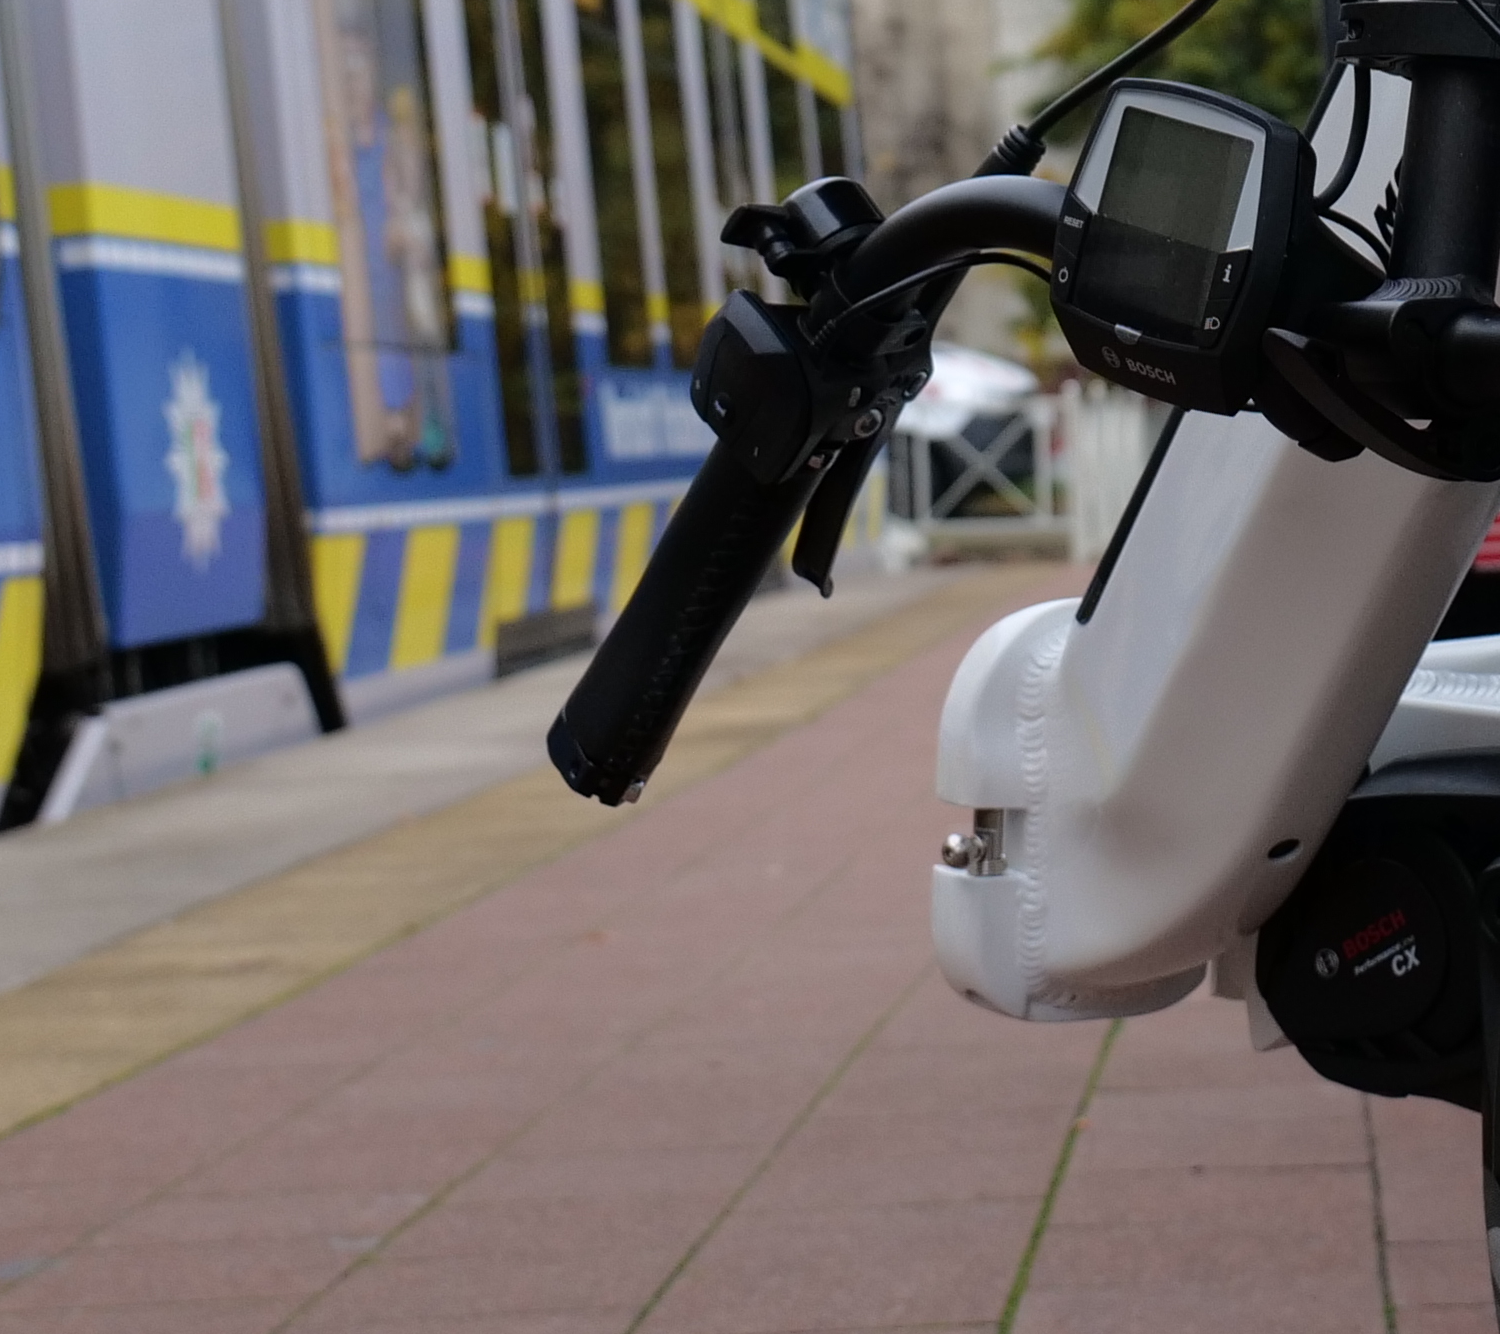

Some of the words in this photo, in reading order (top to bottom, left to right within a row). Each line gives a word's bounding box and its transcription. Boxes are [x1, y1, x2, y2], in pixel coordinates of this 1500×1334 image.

[1125, 356, 1177, 385] BOSCH
[1342, 908, 1407, 960] BOSCH
[1391, 944, 1420, 977] CX
